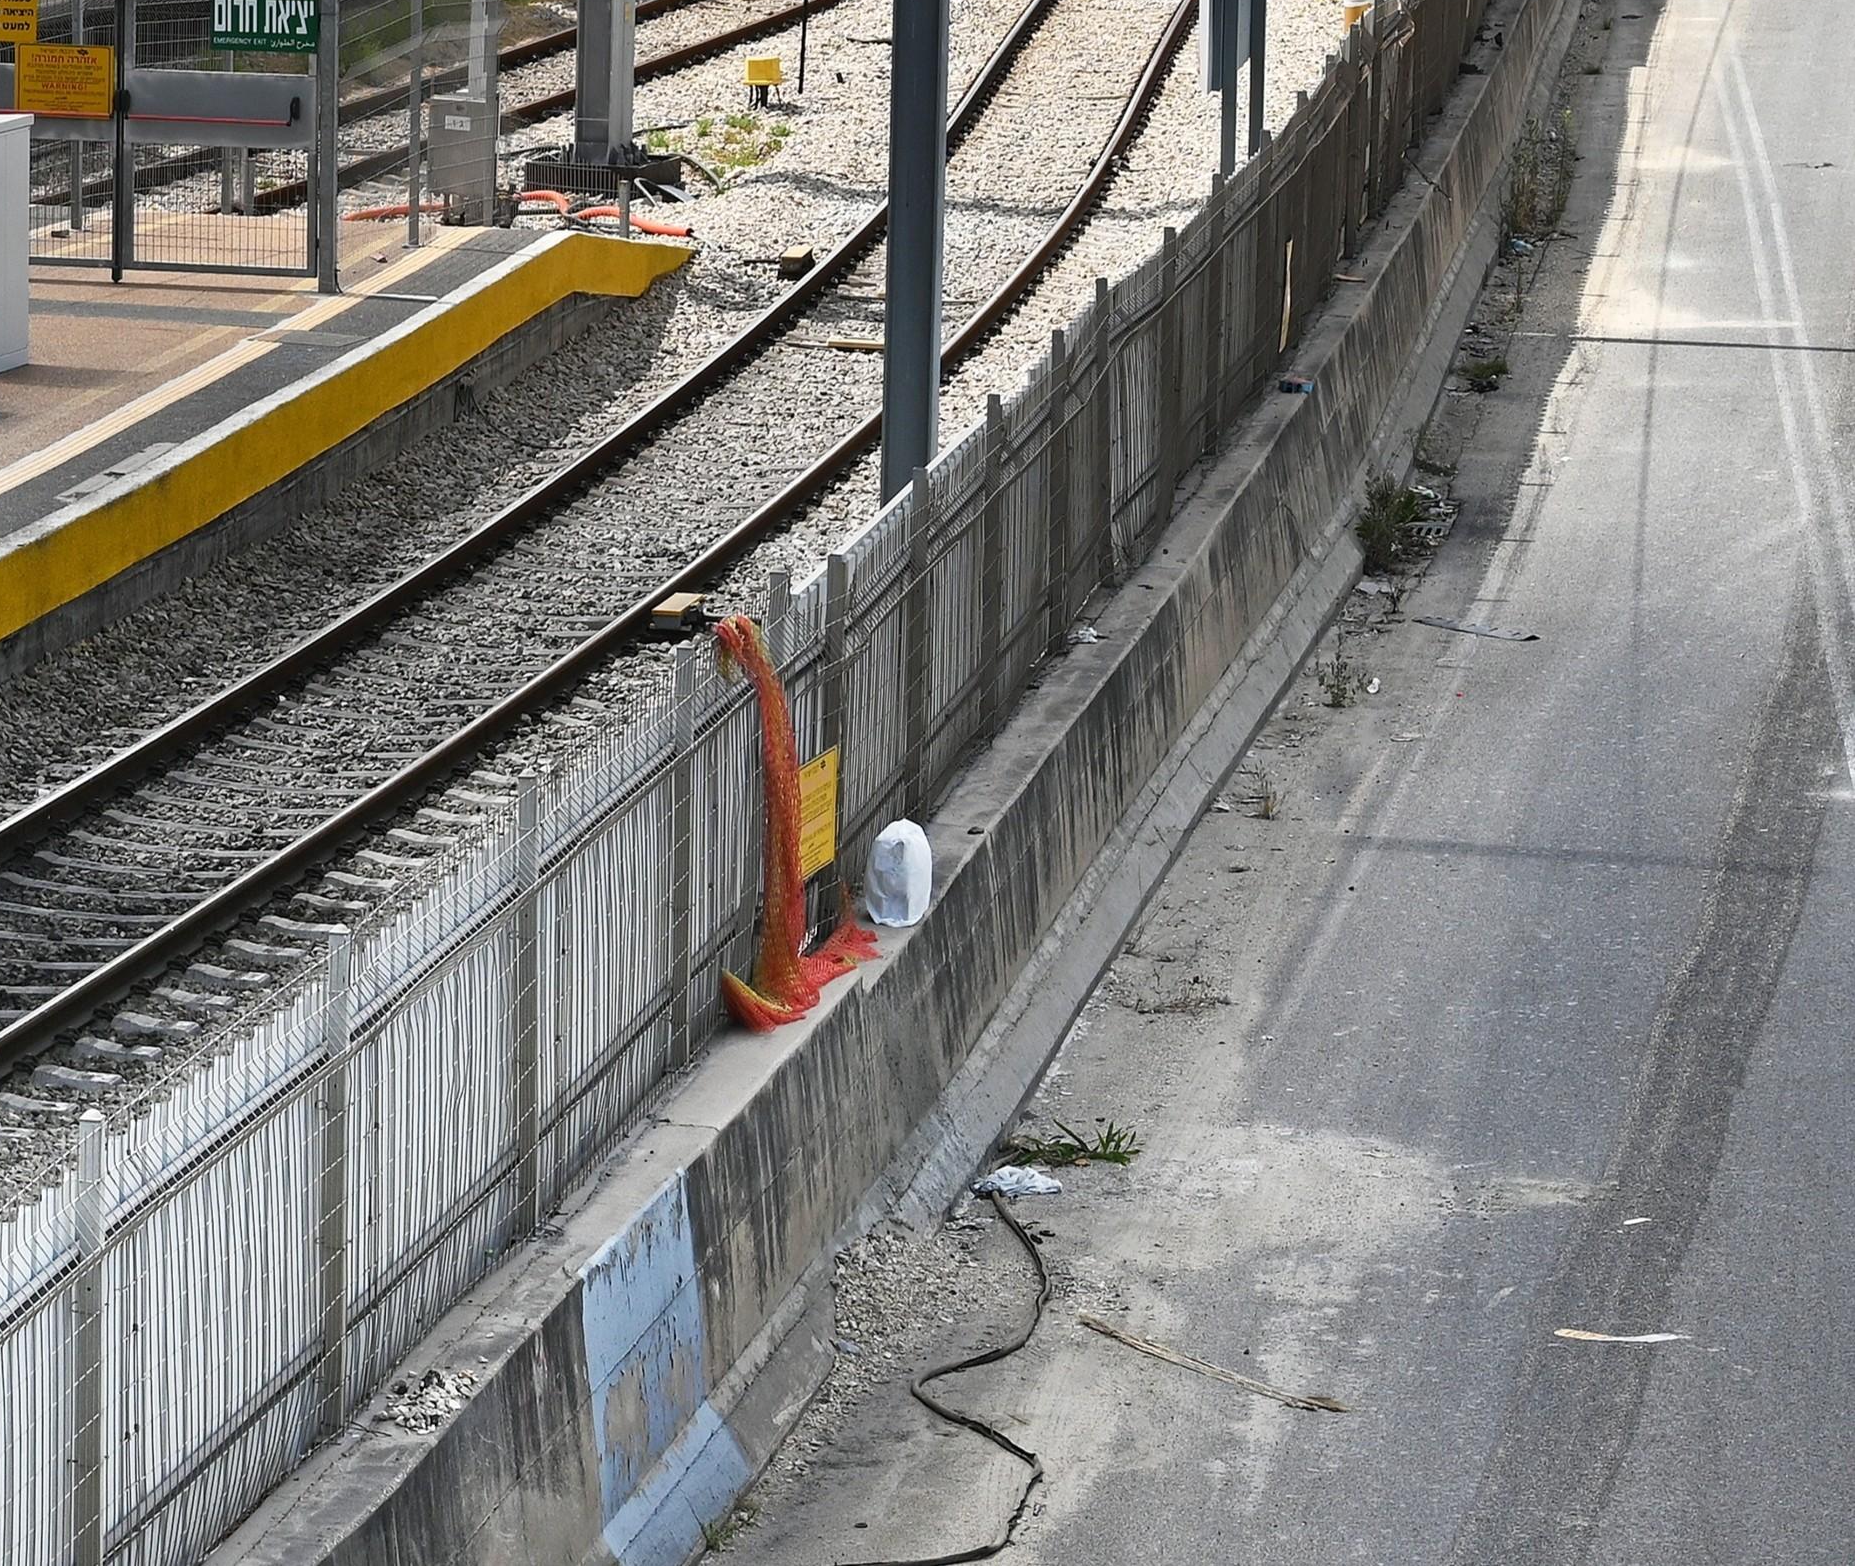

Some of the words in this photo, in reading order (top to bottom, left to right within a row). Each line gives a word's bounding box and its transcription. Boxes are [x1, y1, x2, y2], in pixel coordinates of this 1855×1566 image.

[2, 9, 34, 17] היציאה
[264, 0, 314, 35] יציאת
[213, 37, 251, 45] EMERGENCY
